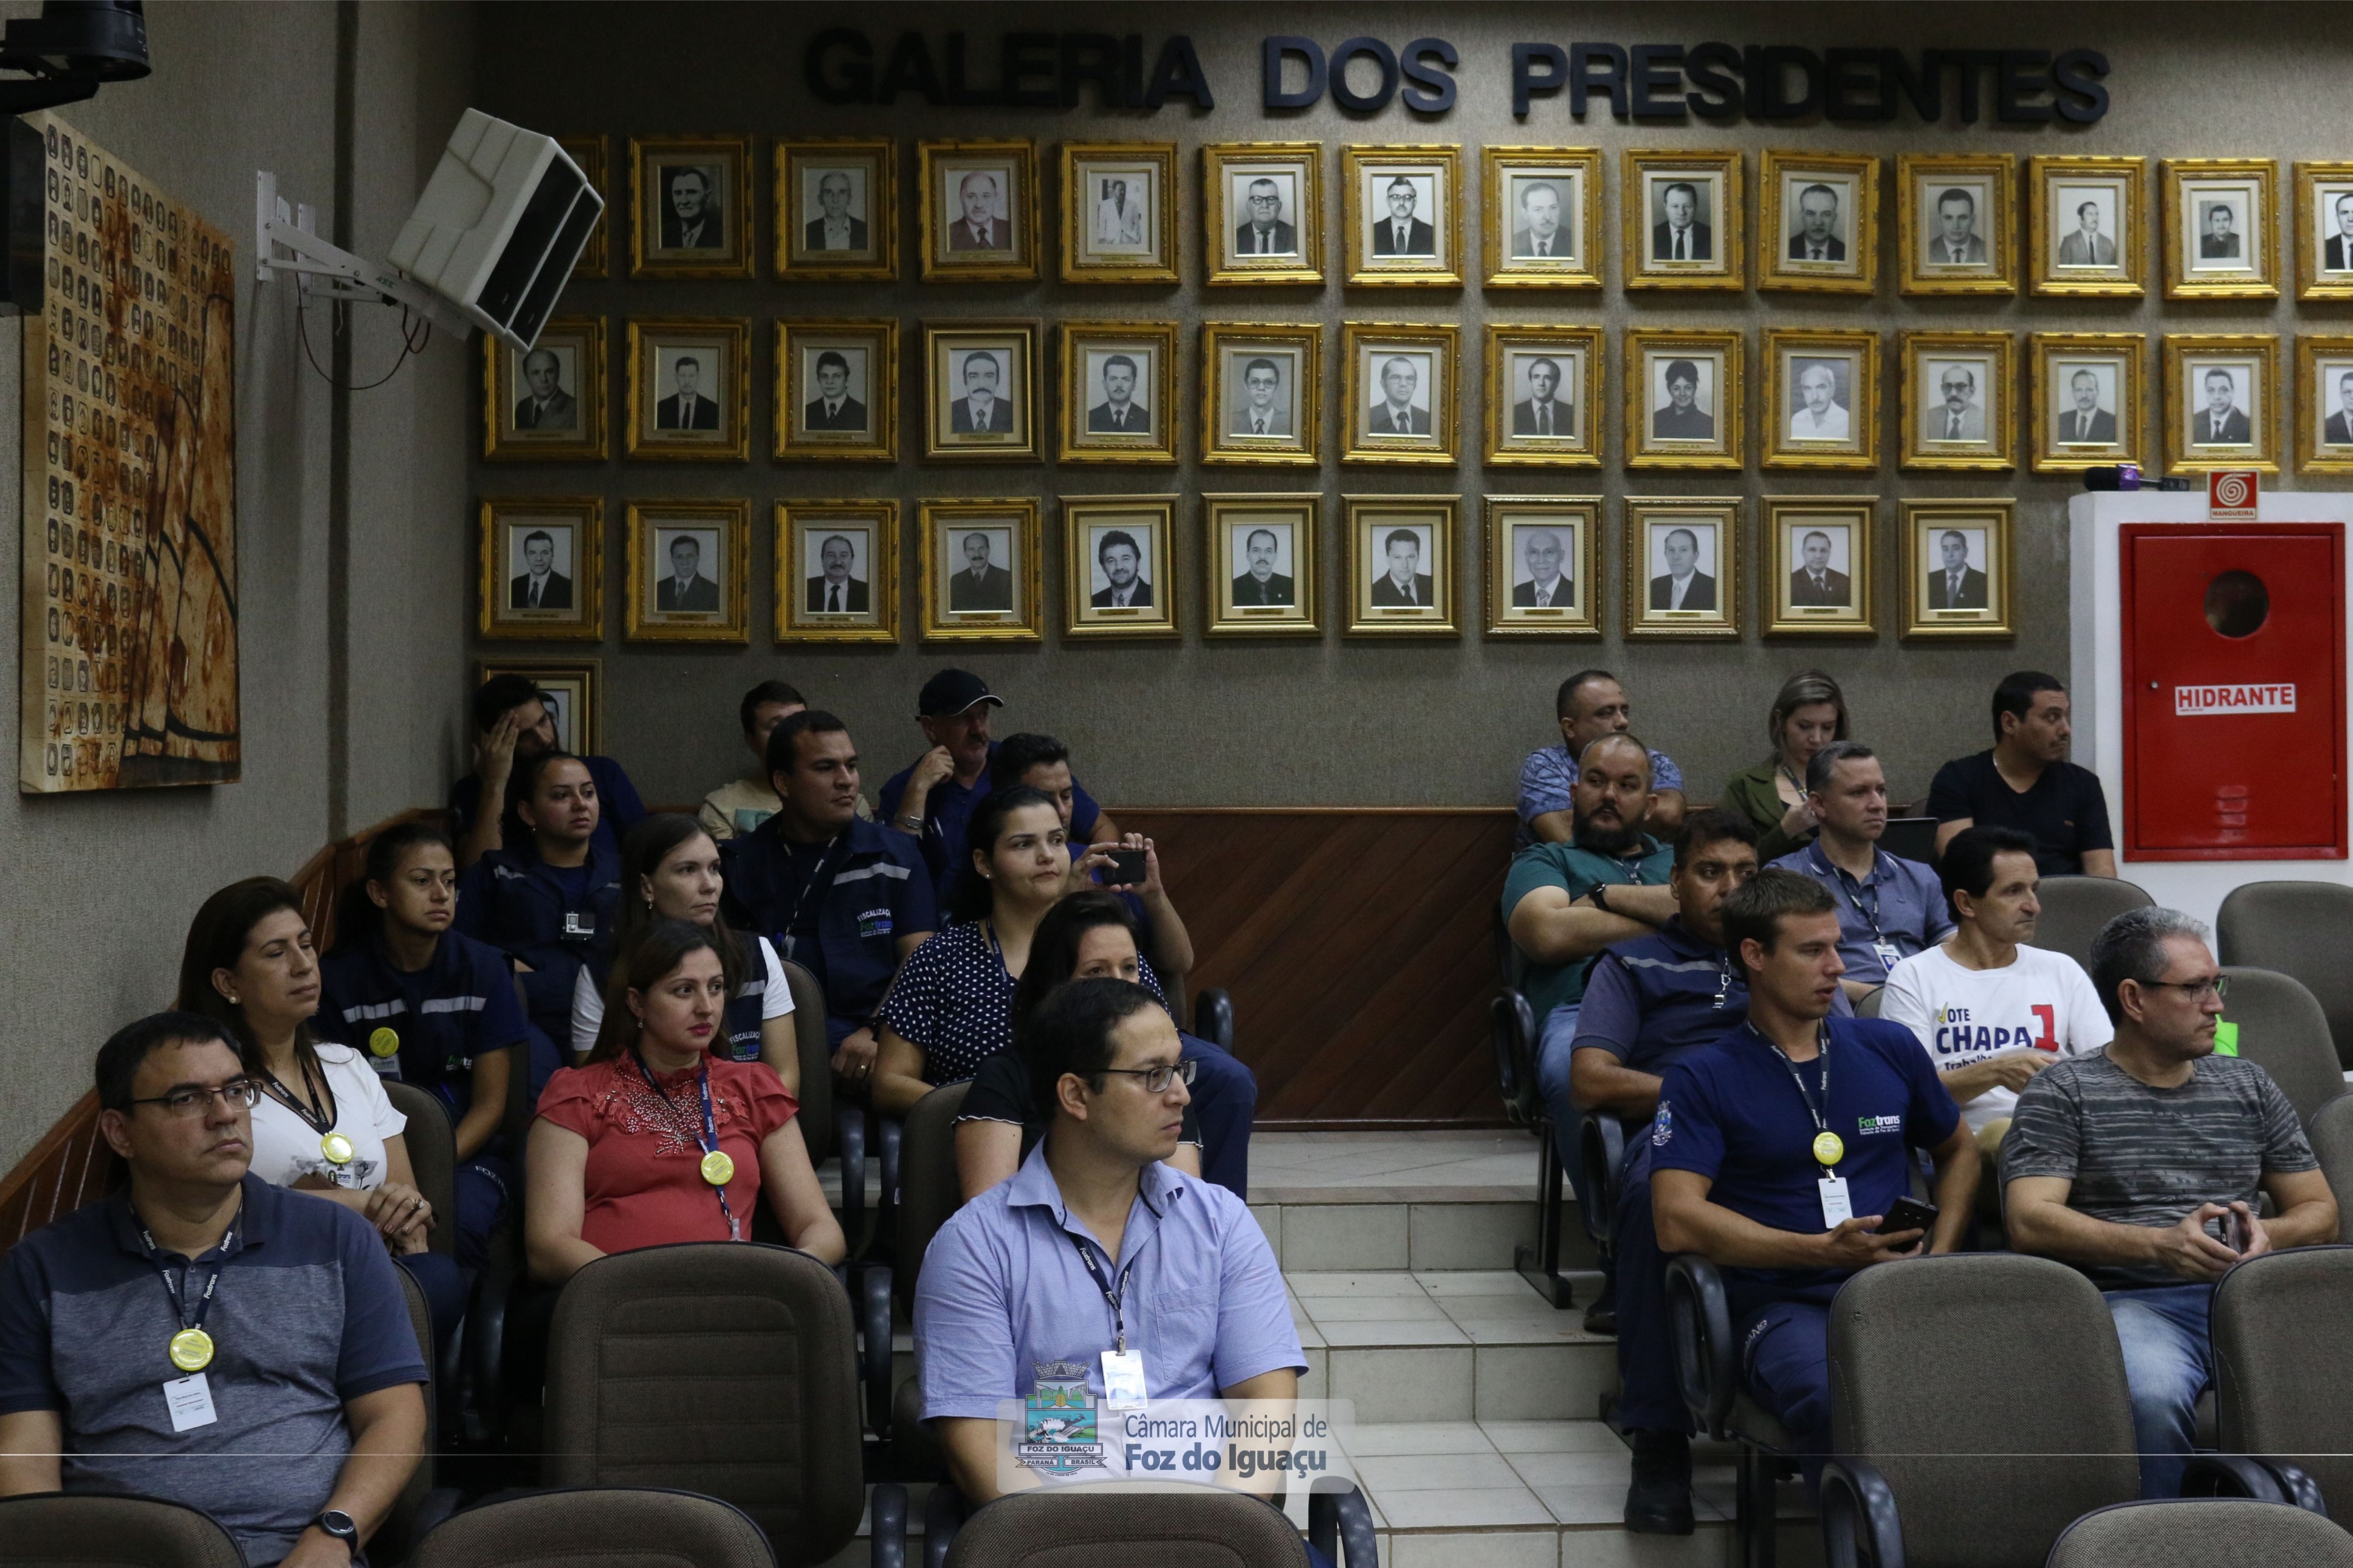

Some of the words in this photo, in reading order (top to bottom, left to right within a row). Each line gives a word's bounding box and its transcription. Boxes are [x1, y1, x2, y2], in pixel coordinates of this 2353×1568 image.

[804, 26, 1214, 111] GALERIA
[1263, 35, 1458, 114] DOS
[1512, 41, 2110, 124] PRESIDENTES
[2178, 686, 2294, 708] HIDRANTE
[1936, 1025, 2033, 1055] CHAPA
[2031, 1004, 2059, 1053] 1
[272, 1081, 289, 1098] Foztrans
[1858, 1115, 1900, 1128] Foztrans
[1080, 1247, 1096, 1271] Foztrans
[204, 1273, 218, 1299] Foztrans
